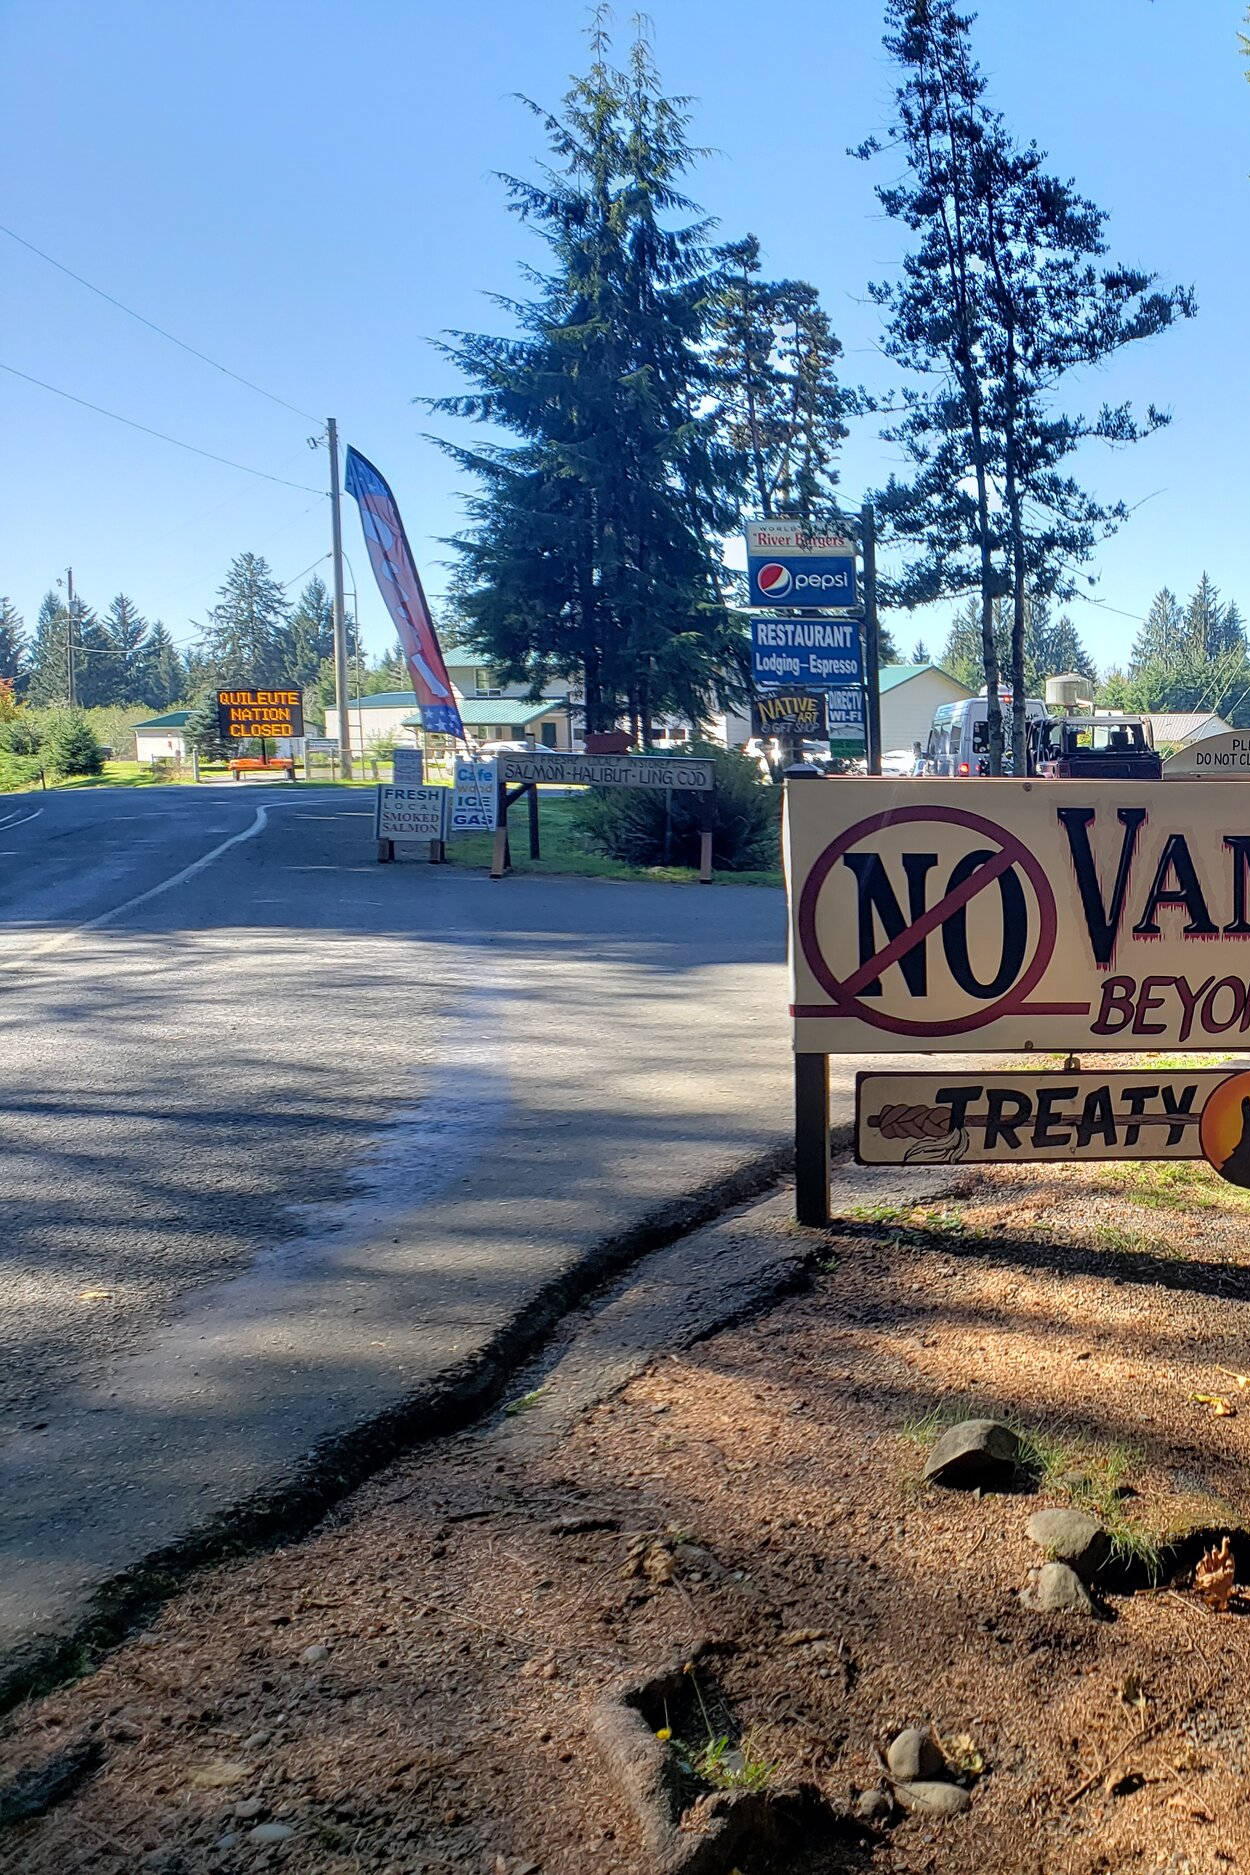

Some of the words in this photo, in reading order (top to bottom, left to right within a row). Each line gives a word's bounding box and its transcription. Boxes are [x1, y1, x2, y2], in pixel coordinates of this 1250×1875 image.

[795, 533, 845, 548] Brgers
[795, 571, 848, 590] pepsi
[757, 624, 853, 648] RESTAURANT
[219, 692, 300, 705] QUILEUTE
[230, 707, 291, 720] NATION
[758, 697, 819, 724] NATIVE
[829, 711, 862, 721] WI-FI
[797, 712, 819, 723] ART
[229, 724, 293, 737] CLOSED
[1196, 753, 1212, 765] DO
[1214, 753, 1237, 766] NOT
[458, 768, 493, 782] Cafe
[505, 763, 565, 780] SALMON
[573, 766, 632, 783] HALIBUT
[639, 769, 674, 785] LING
[677, 771, 706, 786] COD
[385, 788, 440, 801] FRESH
[383, 802, 439, 811] LOCAL
[457, 796, 491, 807] ICE
[382, 811, 439, 823] SMOKED
[453, 814, 493, 825] GAS
[382, 822, 438, 833] SALMON
[843, 850, 1029, 999] NO
[935, 1084, 1199, 1151] TREATY
